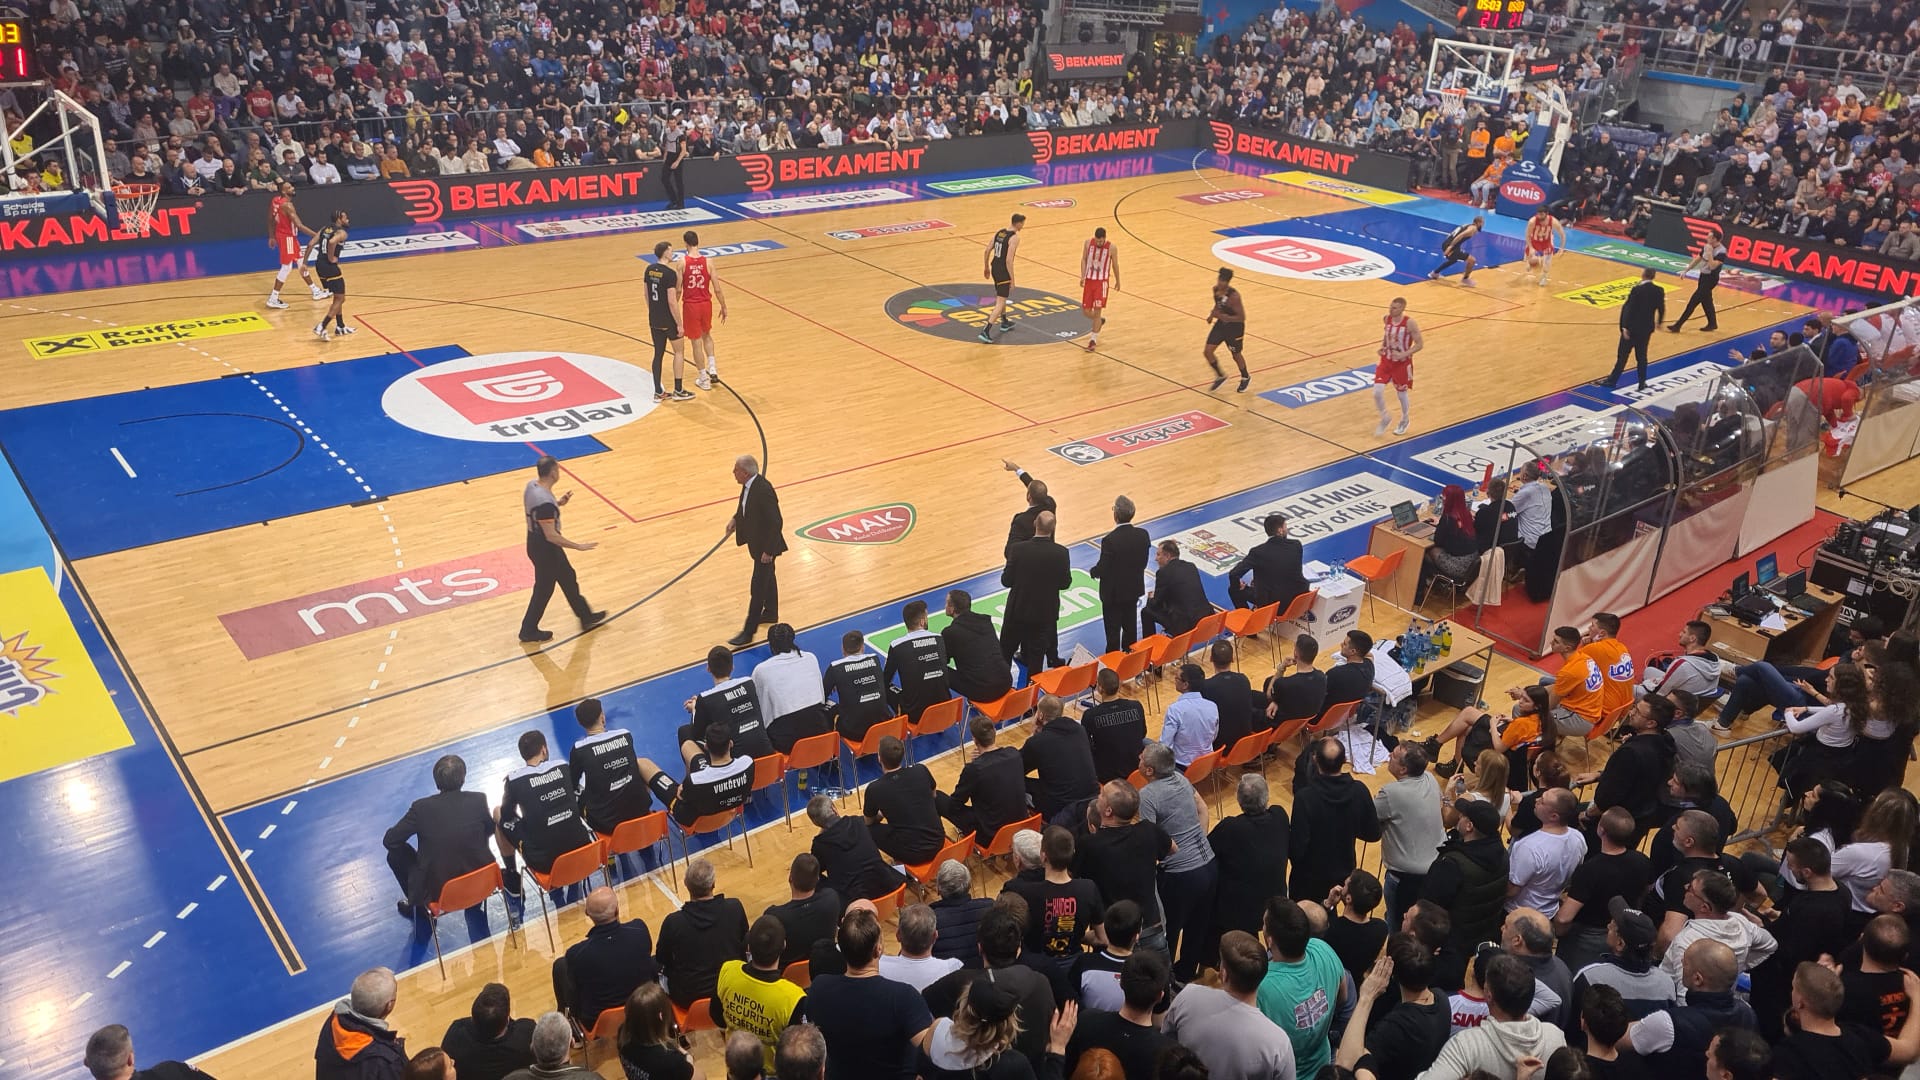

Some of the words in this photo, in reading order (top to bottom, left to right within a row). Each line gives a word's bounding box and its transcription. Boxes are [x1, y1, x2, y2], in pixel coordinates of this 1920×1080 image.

[1065, 54, 1124, 69] BEKAMENT
[1056, 128, 1160, 155] BEKAMENT
[780, 149, 925, 182] BEKAMENT
[1237, 133, 1354, 176] BEKAMENT
[450, 171, 644, 211] BEKAMENT
[1200, 188, 1265, 203] mts
[4, 208, 46, 217] Sports
[0, 206, 197, 251] KAMENT
[1312, 261, 1385, 279] triglav
[1727, 235, 1920, 297] BEKAMENT
[651, 283, 659, 301] 5
[687, 275, 705, 289] 32
[1024, 303, 1081, 318] CLUB
[101, 315, 259, 340] Raiffeisen
[105, 332, 196, 347] Bank
[1277, 369, 1376, 403] RODA
[489, 403, 633, 437] triglav
[1299, 483, 1374, 508] Ниш
[826, 510, 907, 541] MAK
[1288, 519, 1334, 539] City
[1330, 509, 1355, 524] of
[1350, 499, 1387, 518] Niš
[298, 568, 499, 636] mts
[724, 685, 748, 701] MILETIĆ
[731, 701, 753, 714] GLOBOS
[591, 735, 629, 757] TRIFUNOVIĆ
[603, 756, 629, 770] GLOBOS
[529, 767, 564, 788] DANGUBIĆ
[713, 772, 748, 794] VUKČEVIĆ
[540, 786, 566, 801] GLOBOS
[733, 992, 765, 1014] NIFON
